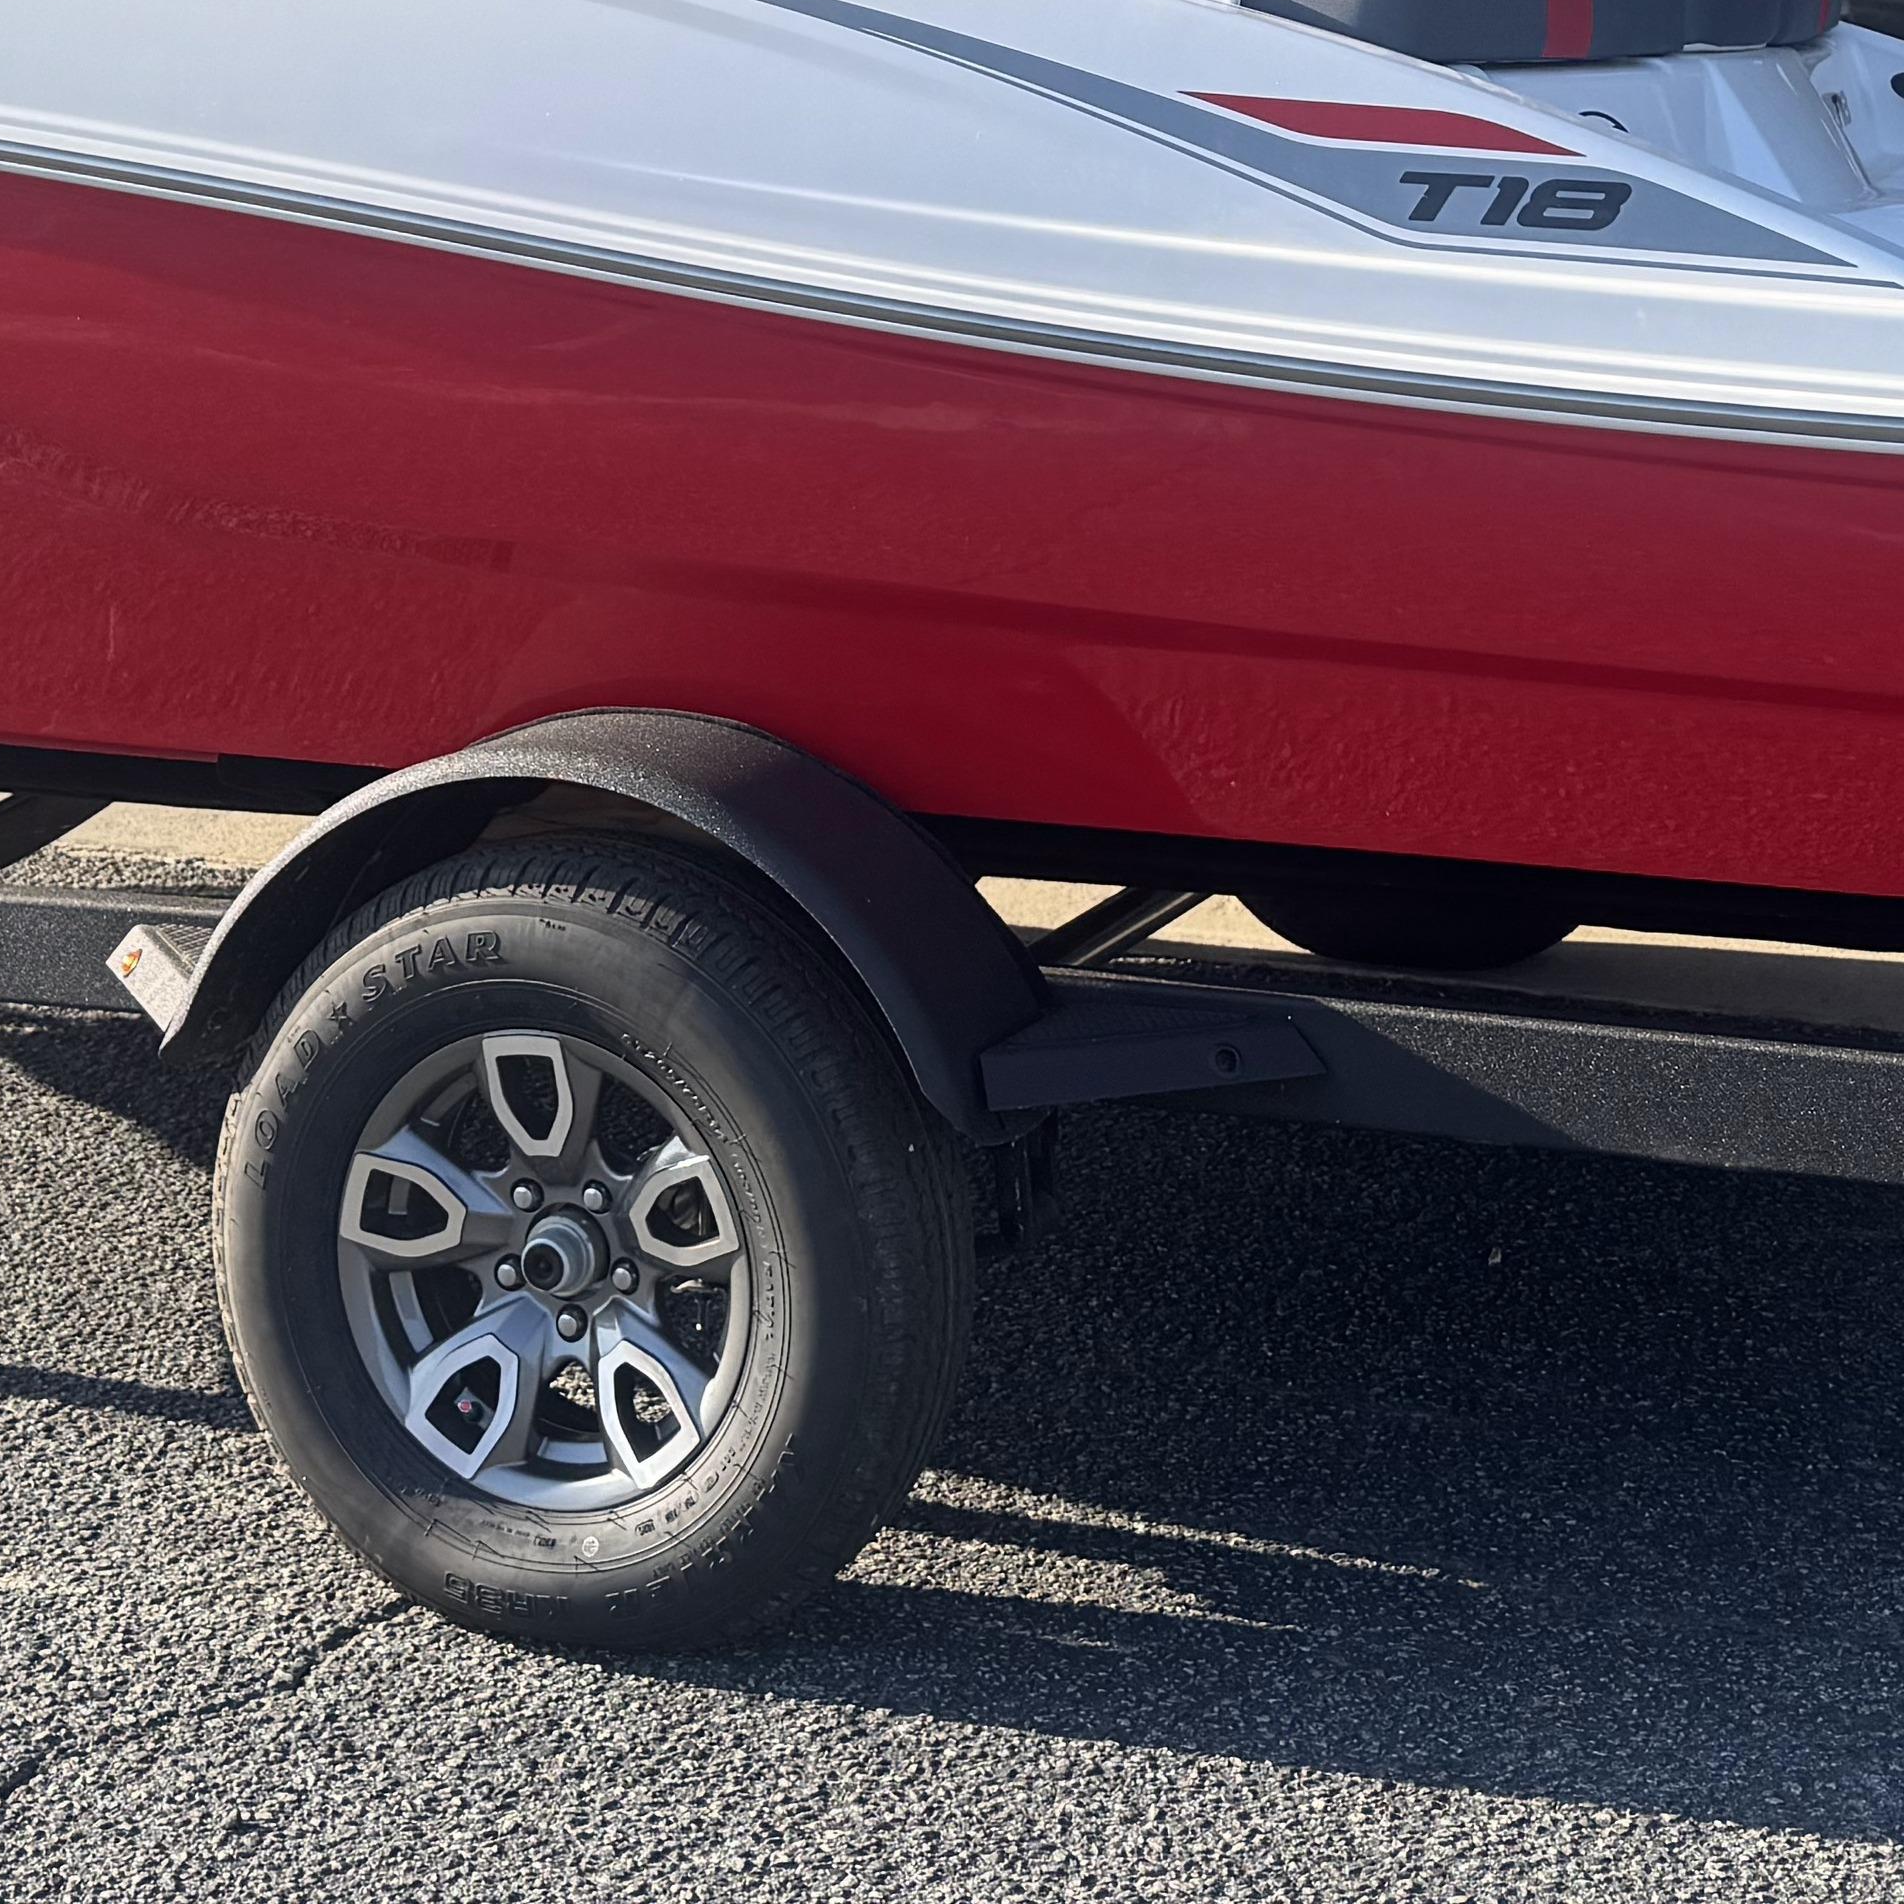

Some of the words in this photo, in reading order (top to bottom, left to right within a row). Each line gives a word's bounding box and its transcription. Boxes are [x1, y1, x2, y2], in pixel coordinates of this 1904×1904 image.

[1399, 171, 1632, 231] T18
[244, 1029, 323, 1191] LOAD
[361, 930, 501, 1002] STAR
